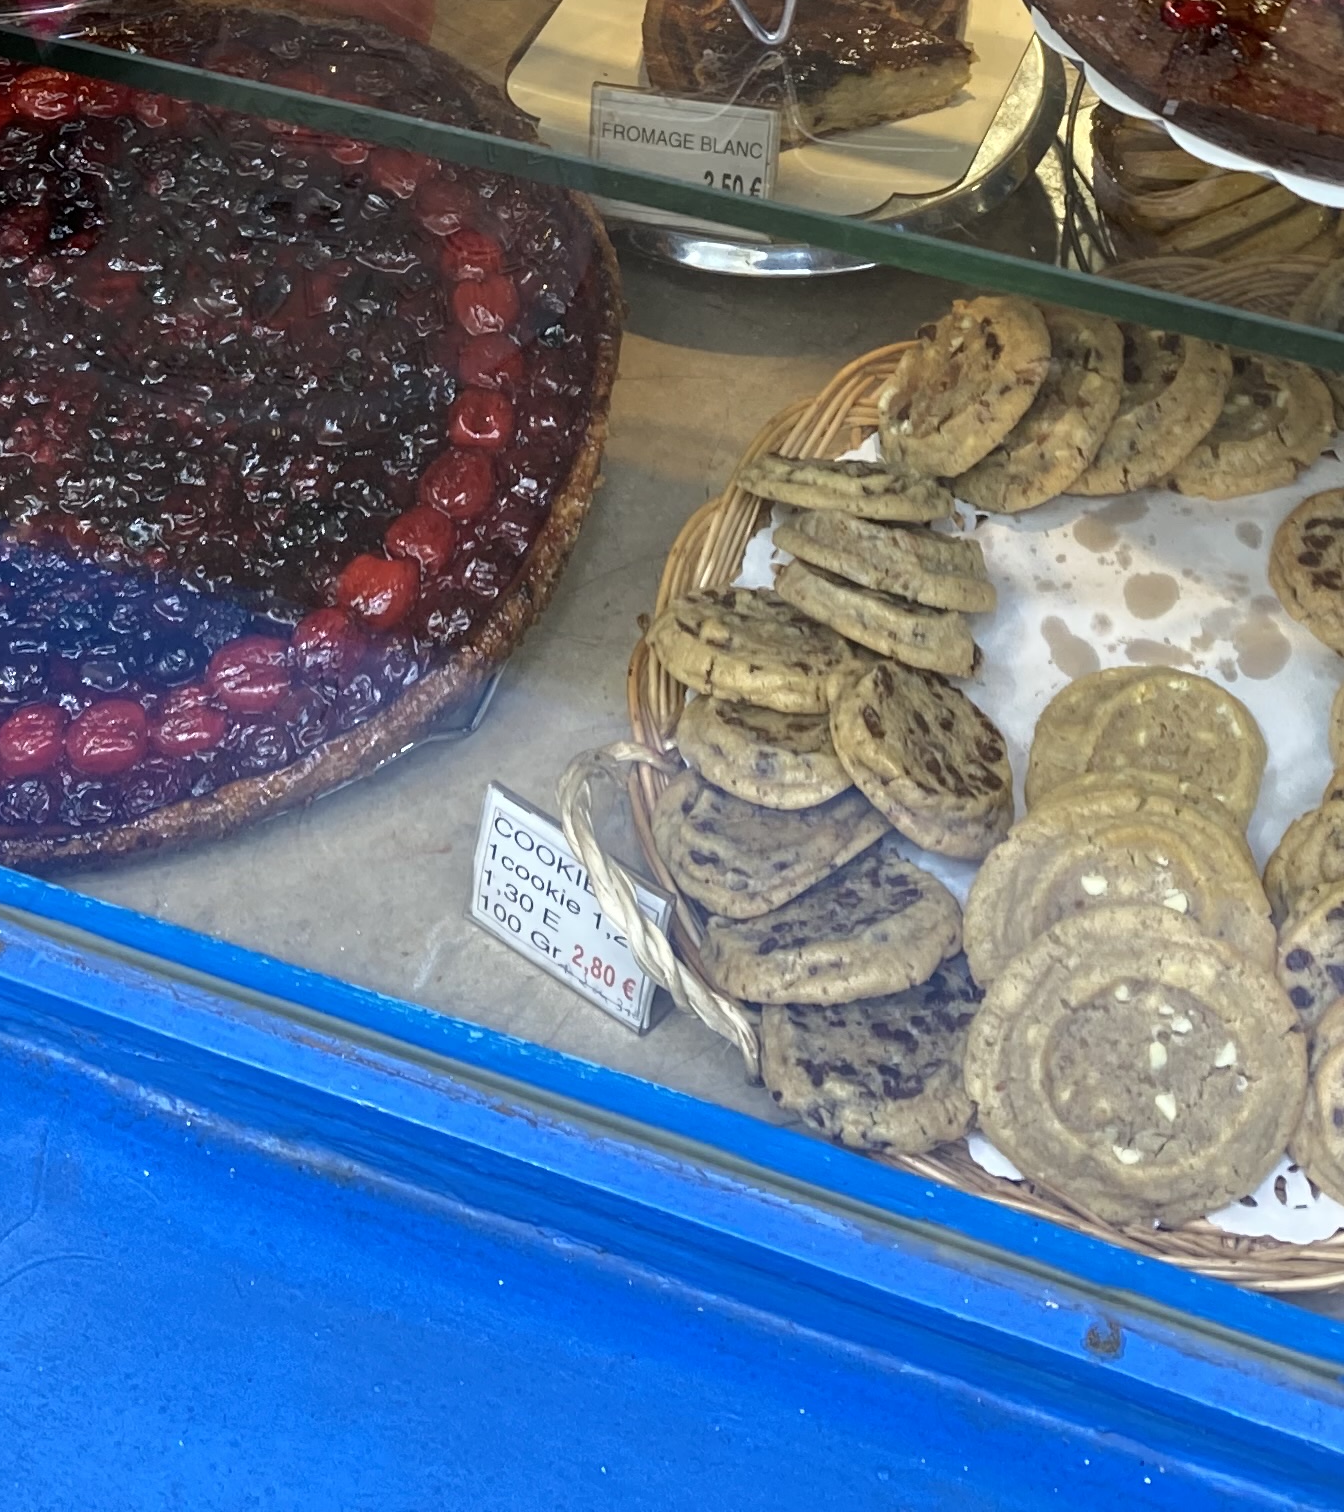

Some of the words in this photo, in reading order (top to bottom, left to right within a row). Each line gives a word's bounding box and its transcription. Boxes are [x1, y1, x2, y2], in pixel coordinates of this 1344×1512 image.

[601, 121, 696, 151] FROMAGE
[699, 135, 764, 160] BLANC
[479, 894, 523, 935] 100
[529, 929, 562, 959] Gr
[483, 869, 536, 914] 1,30
[542, 906, 562, 933] E
[571, 943, 616, 989] 2,80
[622, 977, 638, 1002] €
